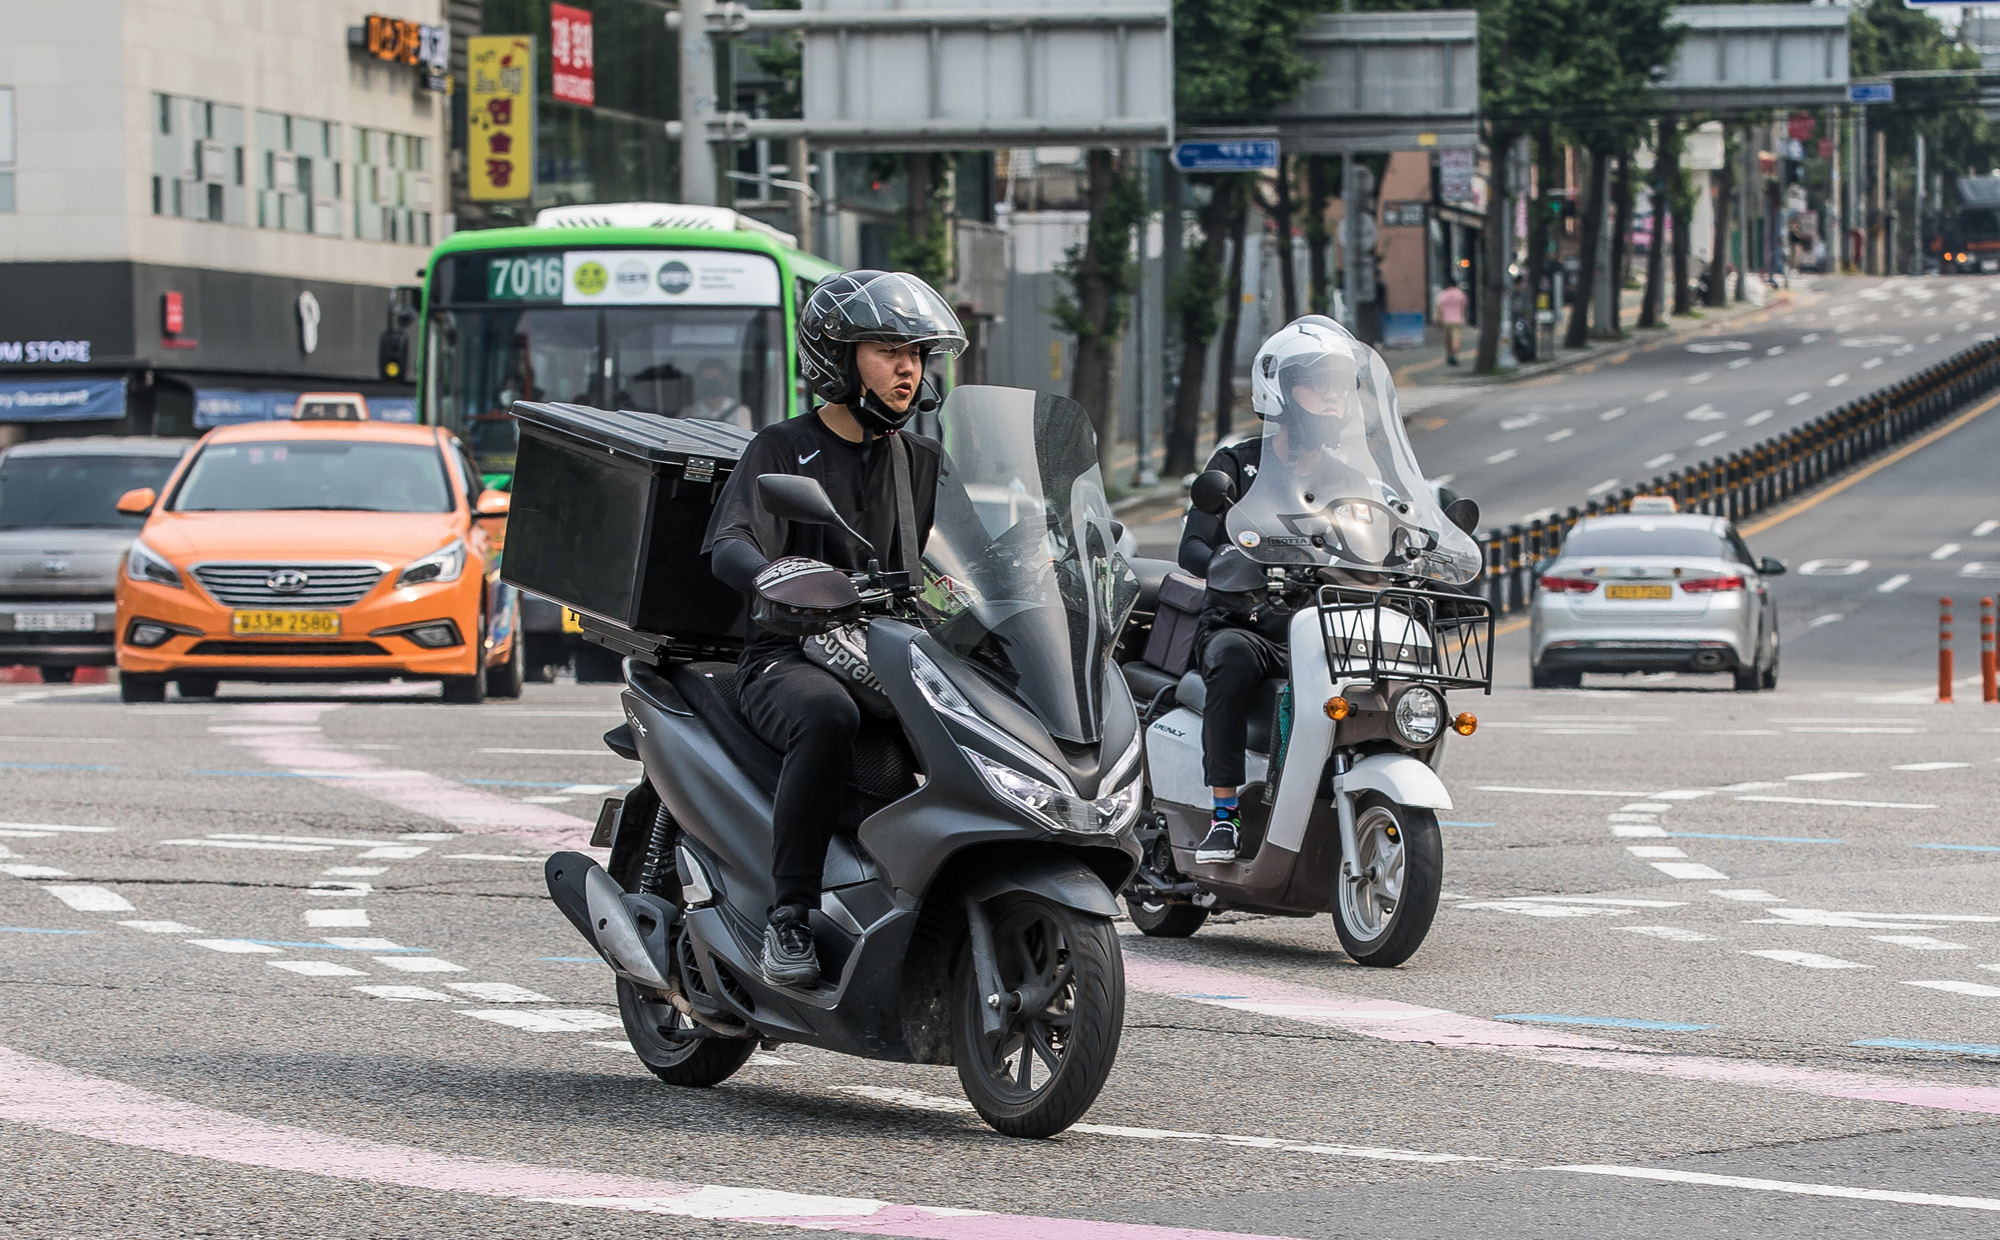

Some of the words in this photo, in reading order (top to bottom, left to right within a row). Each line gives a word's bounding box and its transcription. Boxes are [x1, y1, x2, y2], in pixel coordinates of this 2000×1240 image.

[492, 256, 561, 297] 7016
[25, 340, 91, 363] STORE
[288, 613, 332, 631] 2580
[814, 634, 889, 696] uprem
[1154, 722, 1186, 737] BENLY
